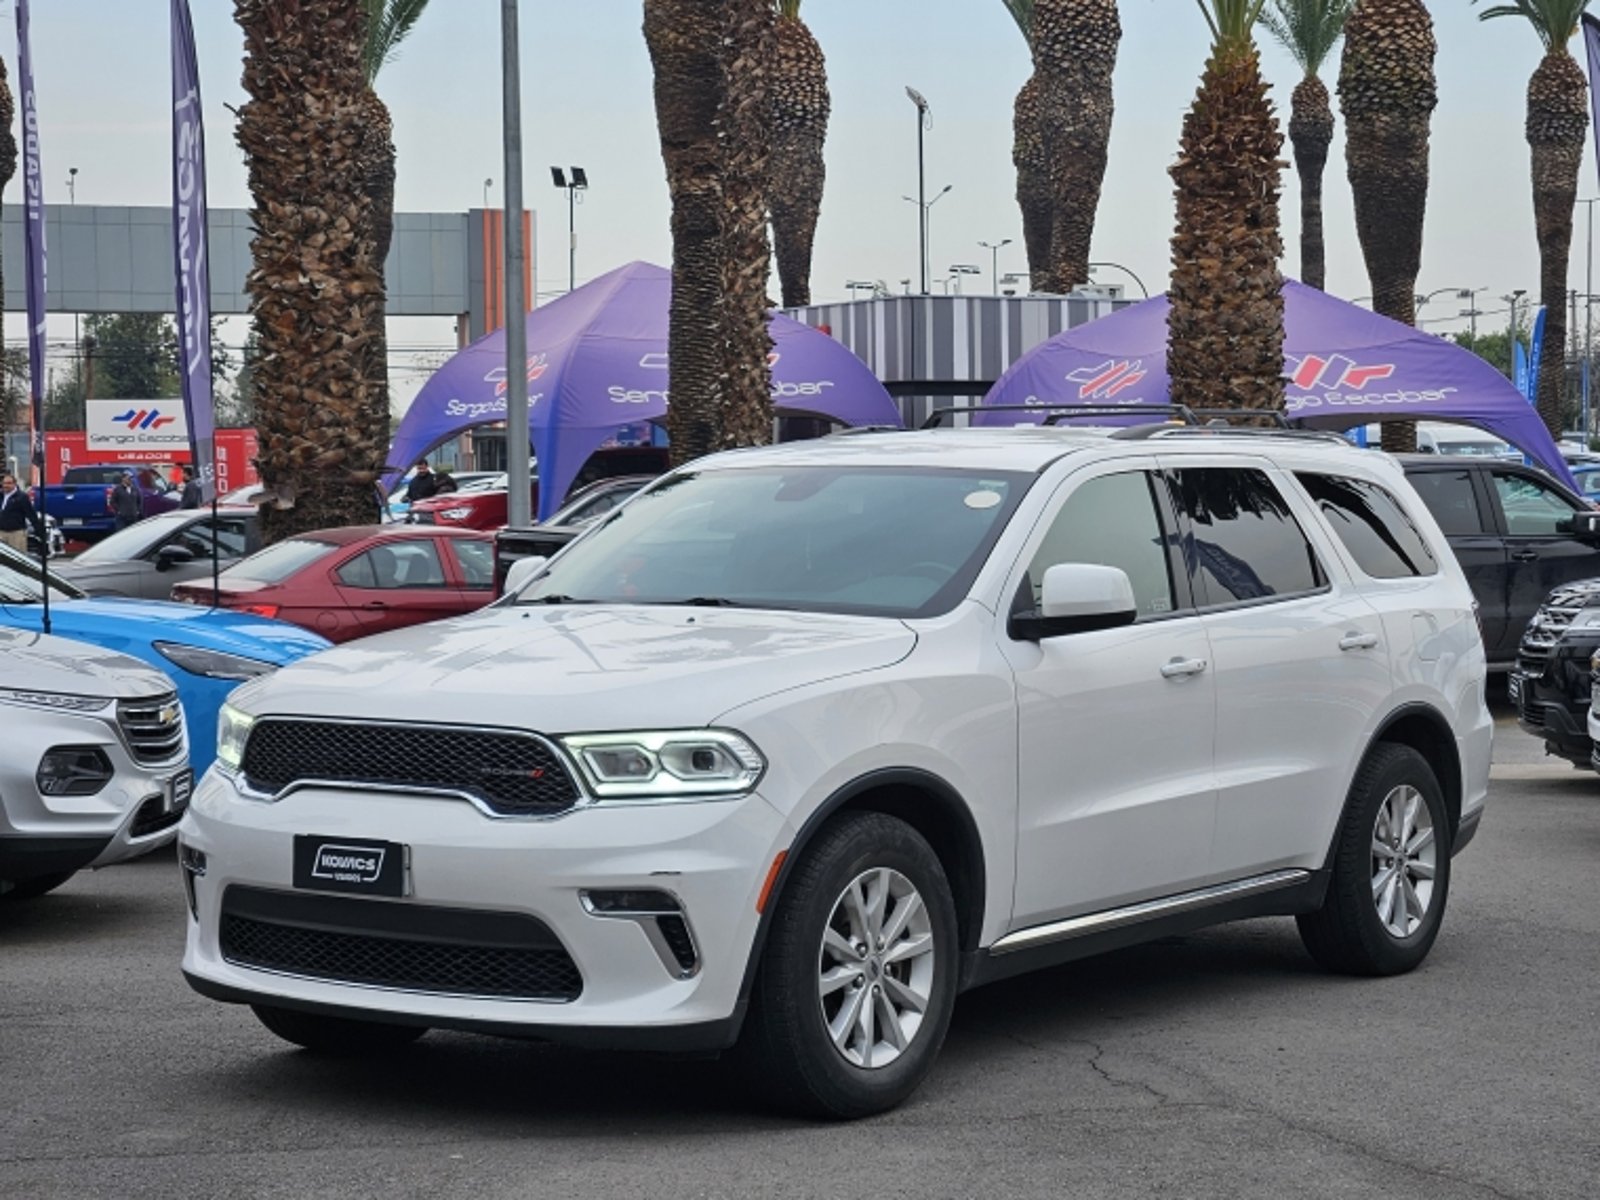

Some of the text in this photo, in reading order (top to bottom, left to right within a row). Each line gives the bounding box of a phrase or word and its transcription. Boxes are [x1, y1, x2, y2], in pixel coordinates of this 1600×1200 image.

[1324, 387, 1459, 406] Escobar
[138, 432, 190, 443] Escoba
[321, 854, 376, 871] KOVACS
